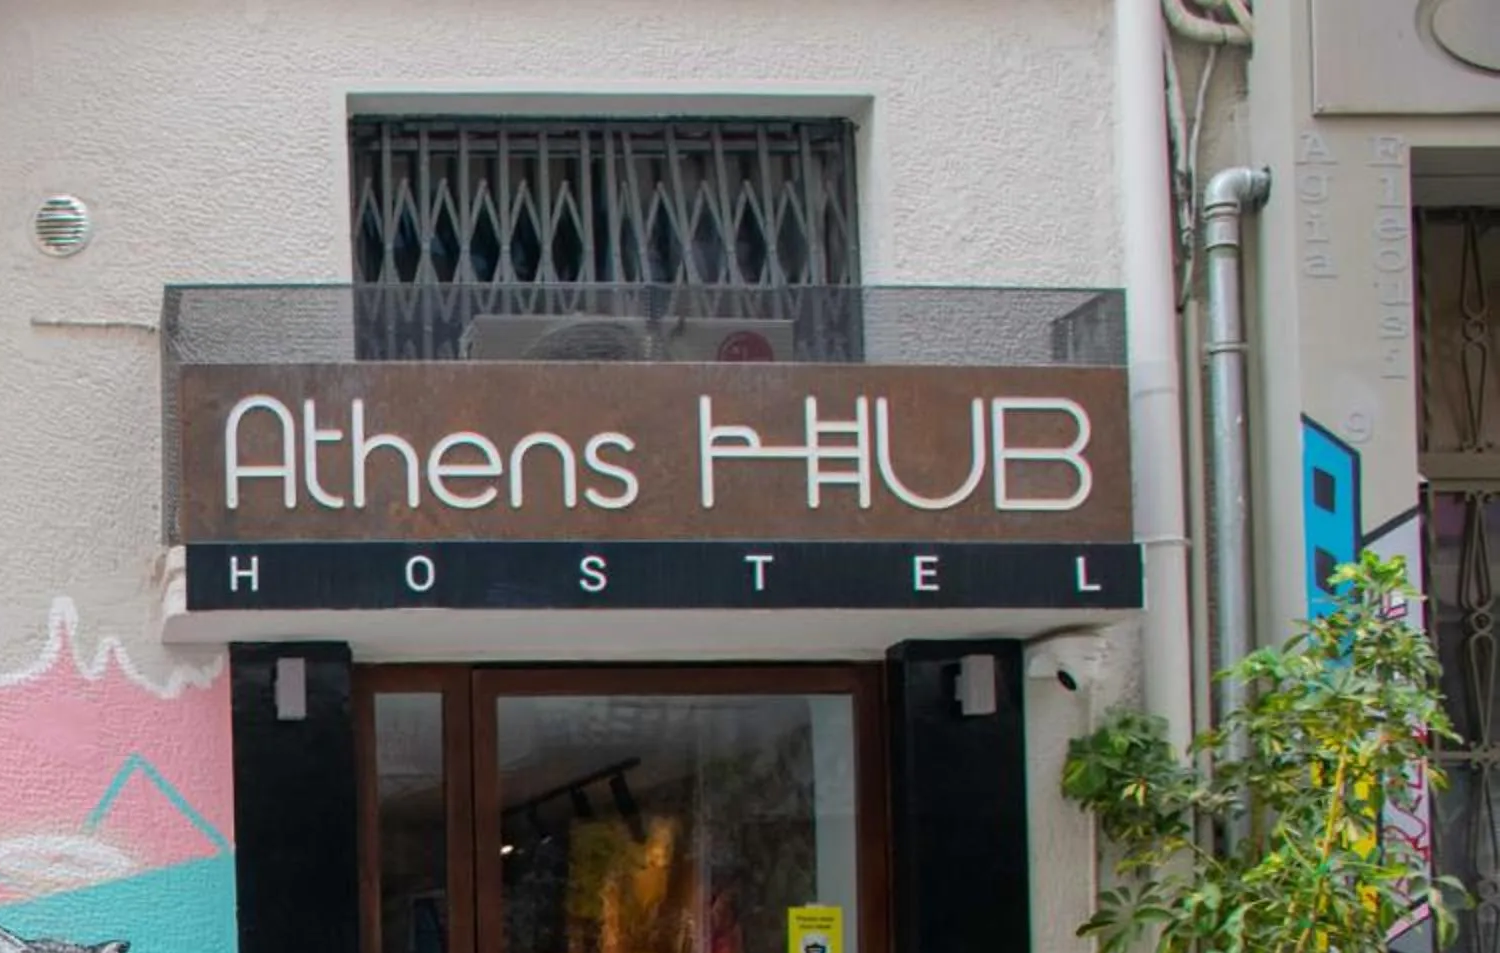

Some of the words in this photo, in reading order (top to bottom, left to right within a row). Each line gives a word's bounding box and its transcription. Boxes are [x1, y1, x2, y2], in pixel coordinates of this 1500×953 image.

[225, 394, 640, 510] Athens
[699, 394, 1093, 512] HUB
[229, 555, 1102, 593] HOSTEL
